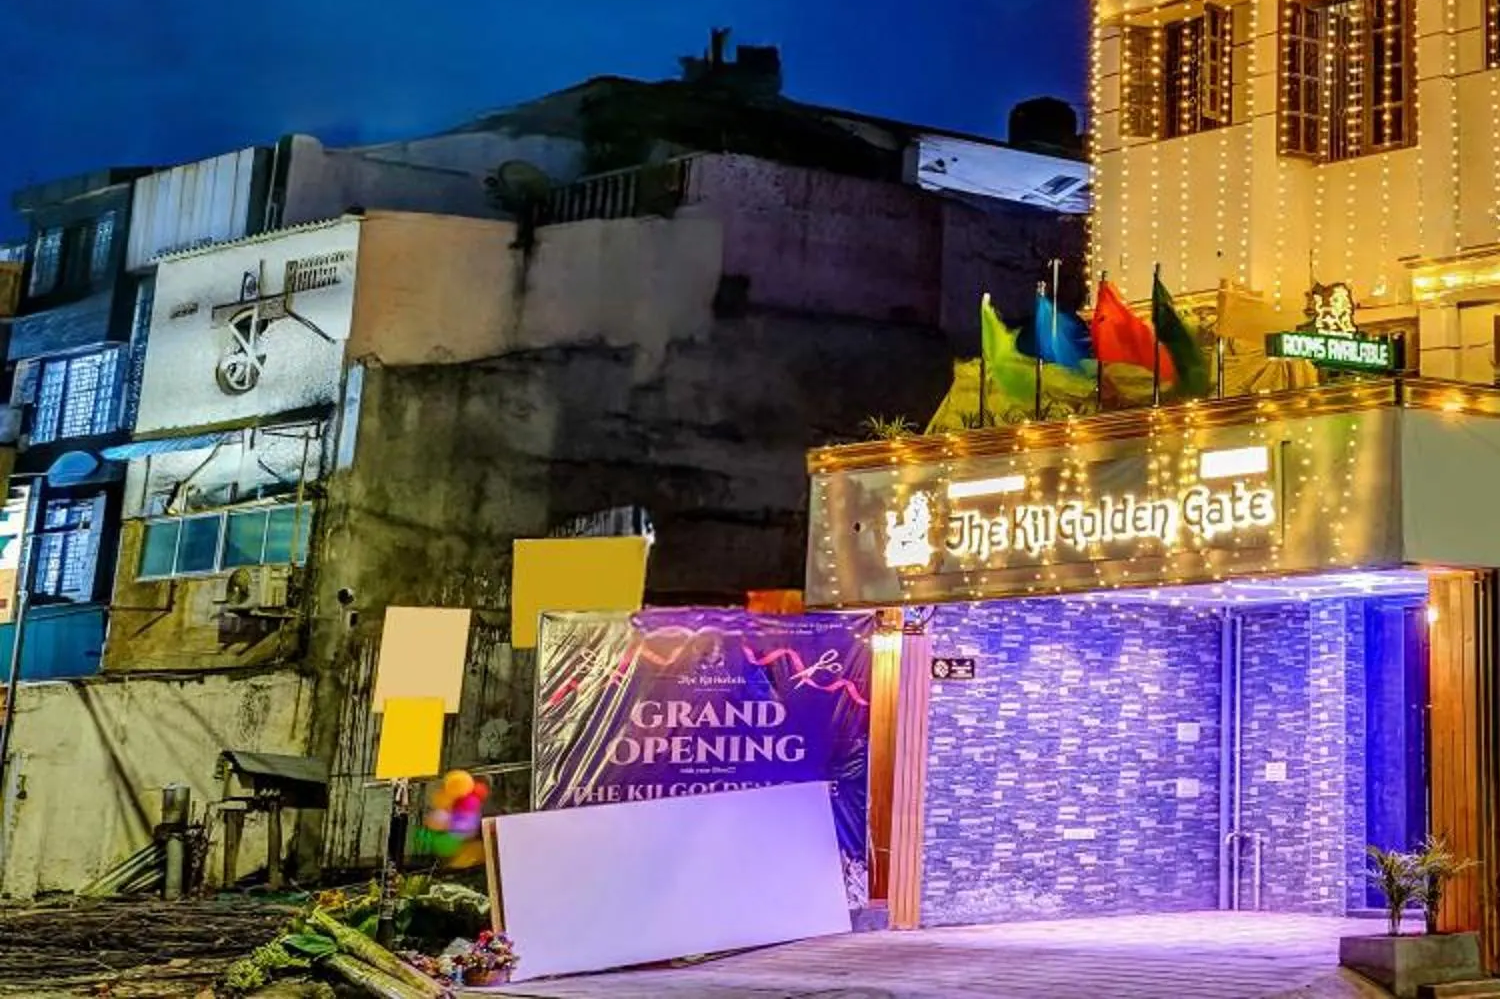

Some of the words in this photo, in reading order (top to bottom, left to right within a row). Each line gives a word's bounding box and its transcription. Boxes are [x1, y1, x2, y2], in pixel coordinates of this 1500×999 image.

[1282, 334, 1326, 359] ROOMS
[1327, 338, 1388, 365] AVAILABLE
[945, 510, 1003, 556] The
[1057, 495, 1174, 547] Golden
[1182, 483, 1271, 536] Gate
[630, 700, 786, 728] GRAND
[607, 735, 807, 765] OPENING
